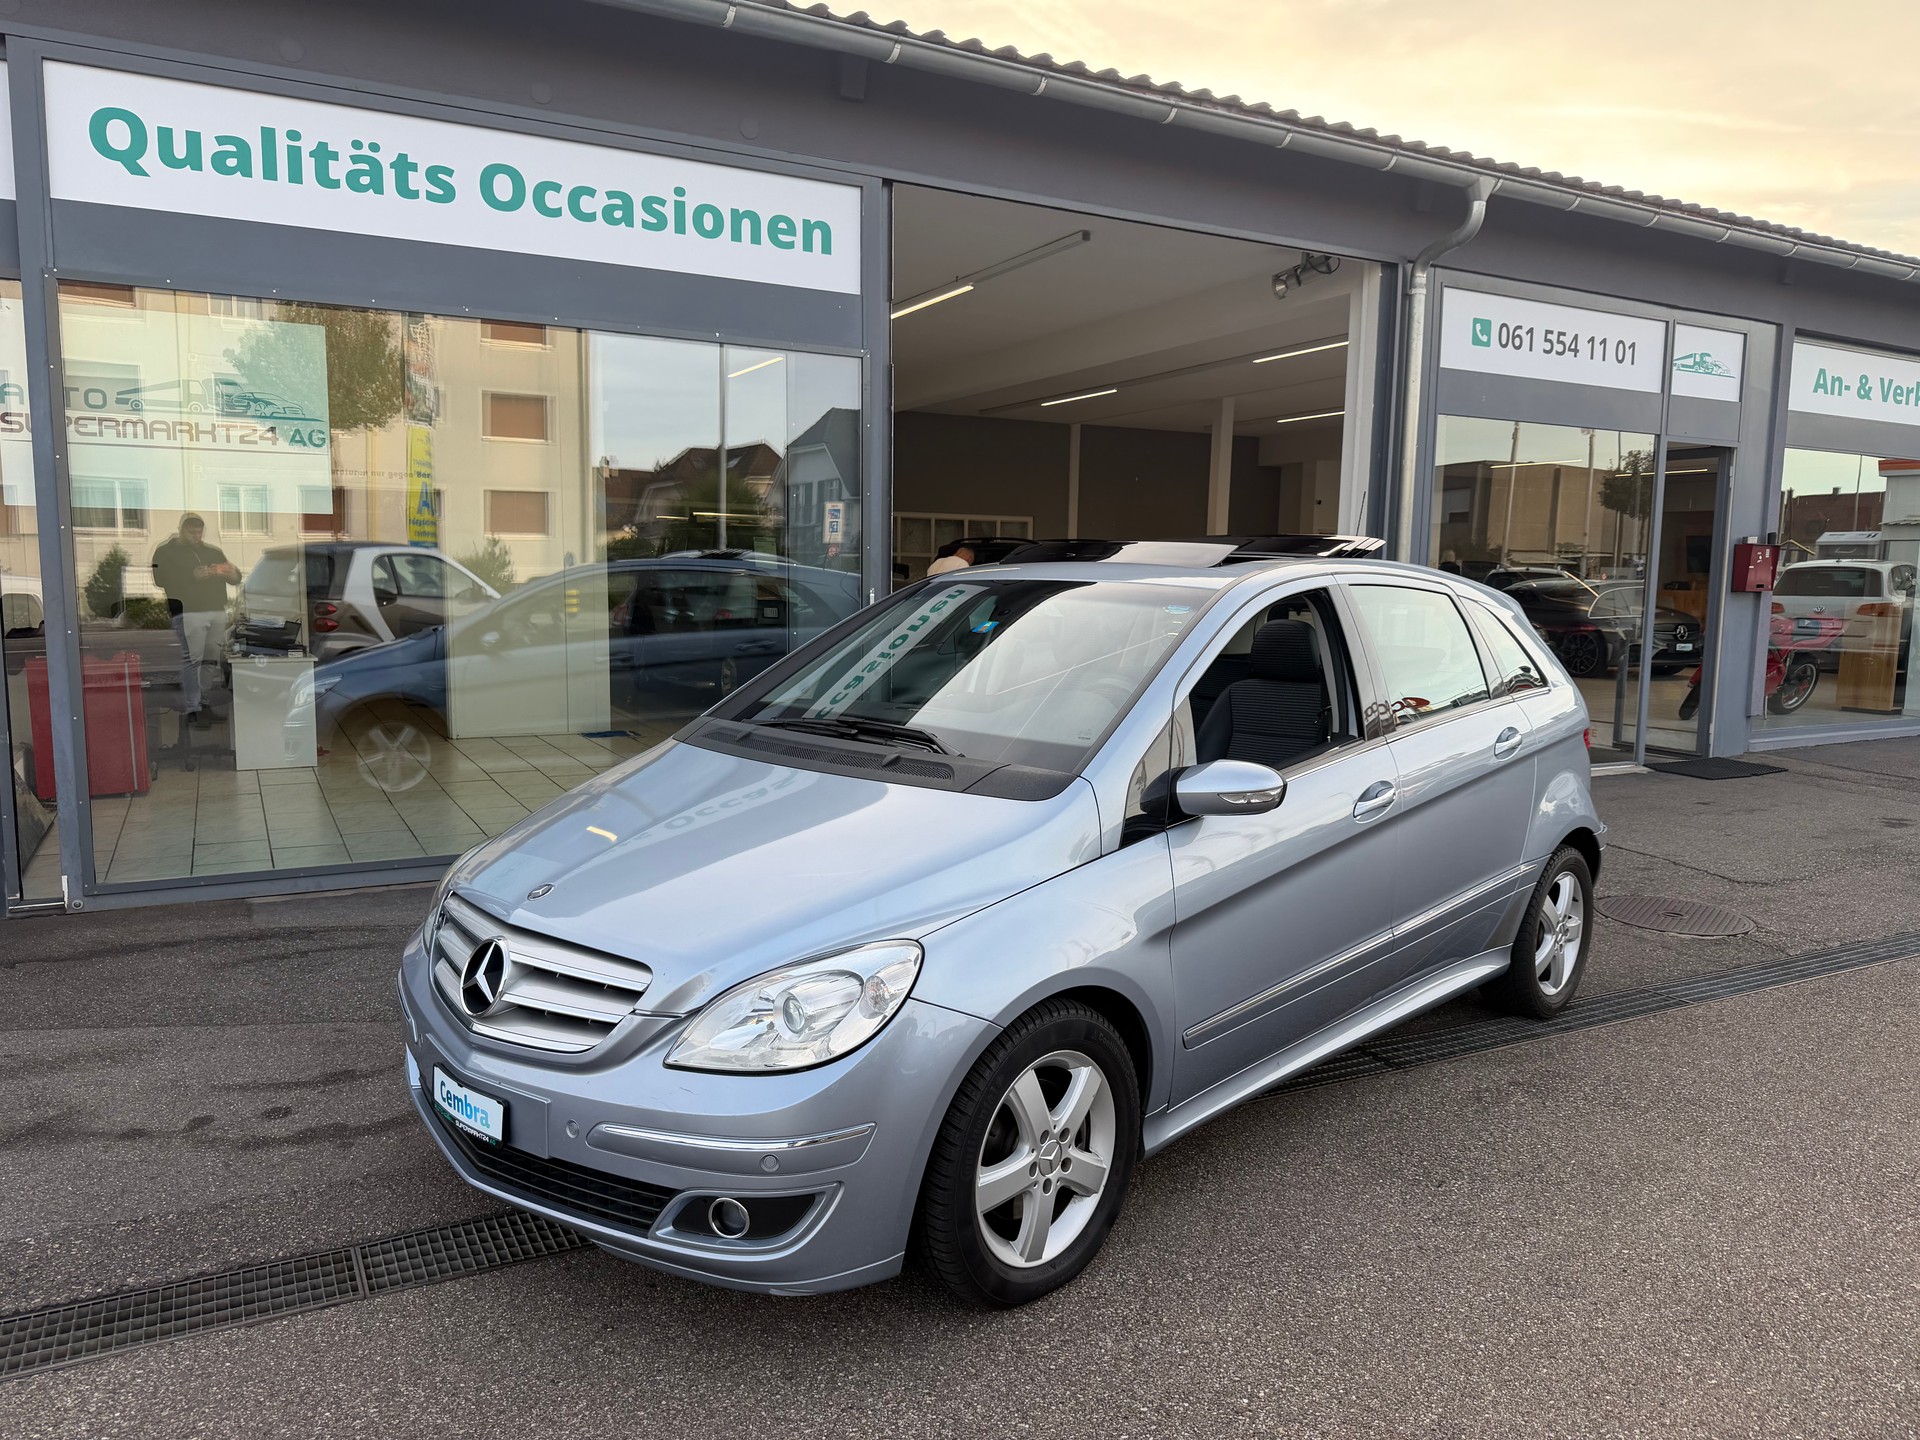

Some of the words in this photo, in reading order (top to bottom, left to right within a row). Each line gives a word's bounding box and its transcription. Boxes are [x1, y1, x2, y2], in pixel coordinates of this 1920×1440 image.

[88, 107, 456, 204] Qualitäts
[479, 163, 832, 255] Occasionen
[1498, 322, 1534, 352] 061
[1542, 329, 1579, 358] 554
[1587, 335, 1607, 362] 11
[1615, 339, 1636, 366] 01
[0, 382, 108, 410] ATO
[1813, 368, 1851, 396] An-
[1857, 374, 1873, 400] &
[289, 428, 327, 448] AG
[440, 1080, 491, 1129] Cembra
